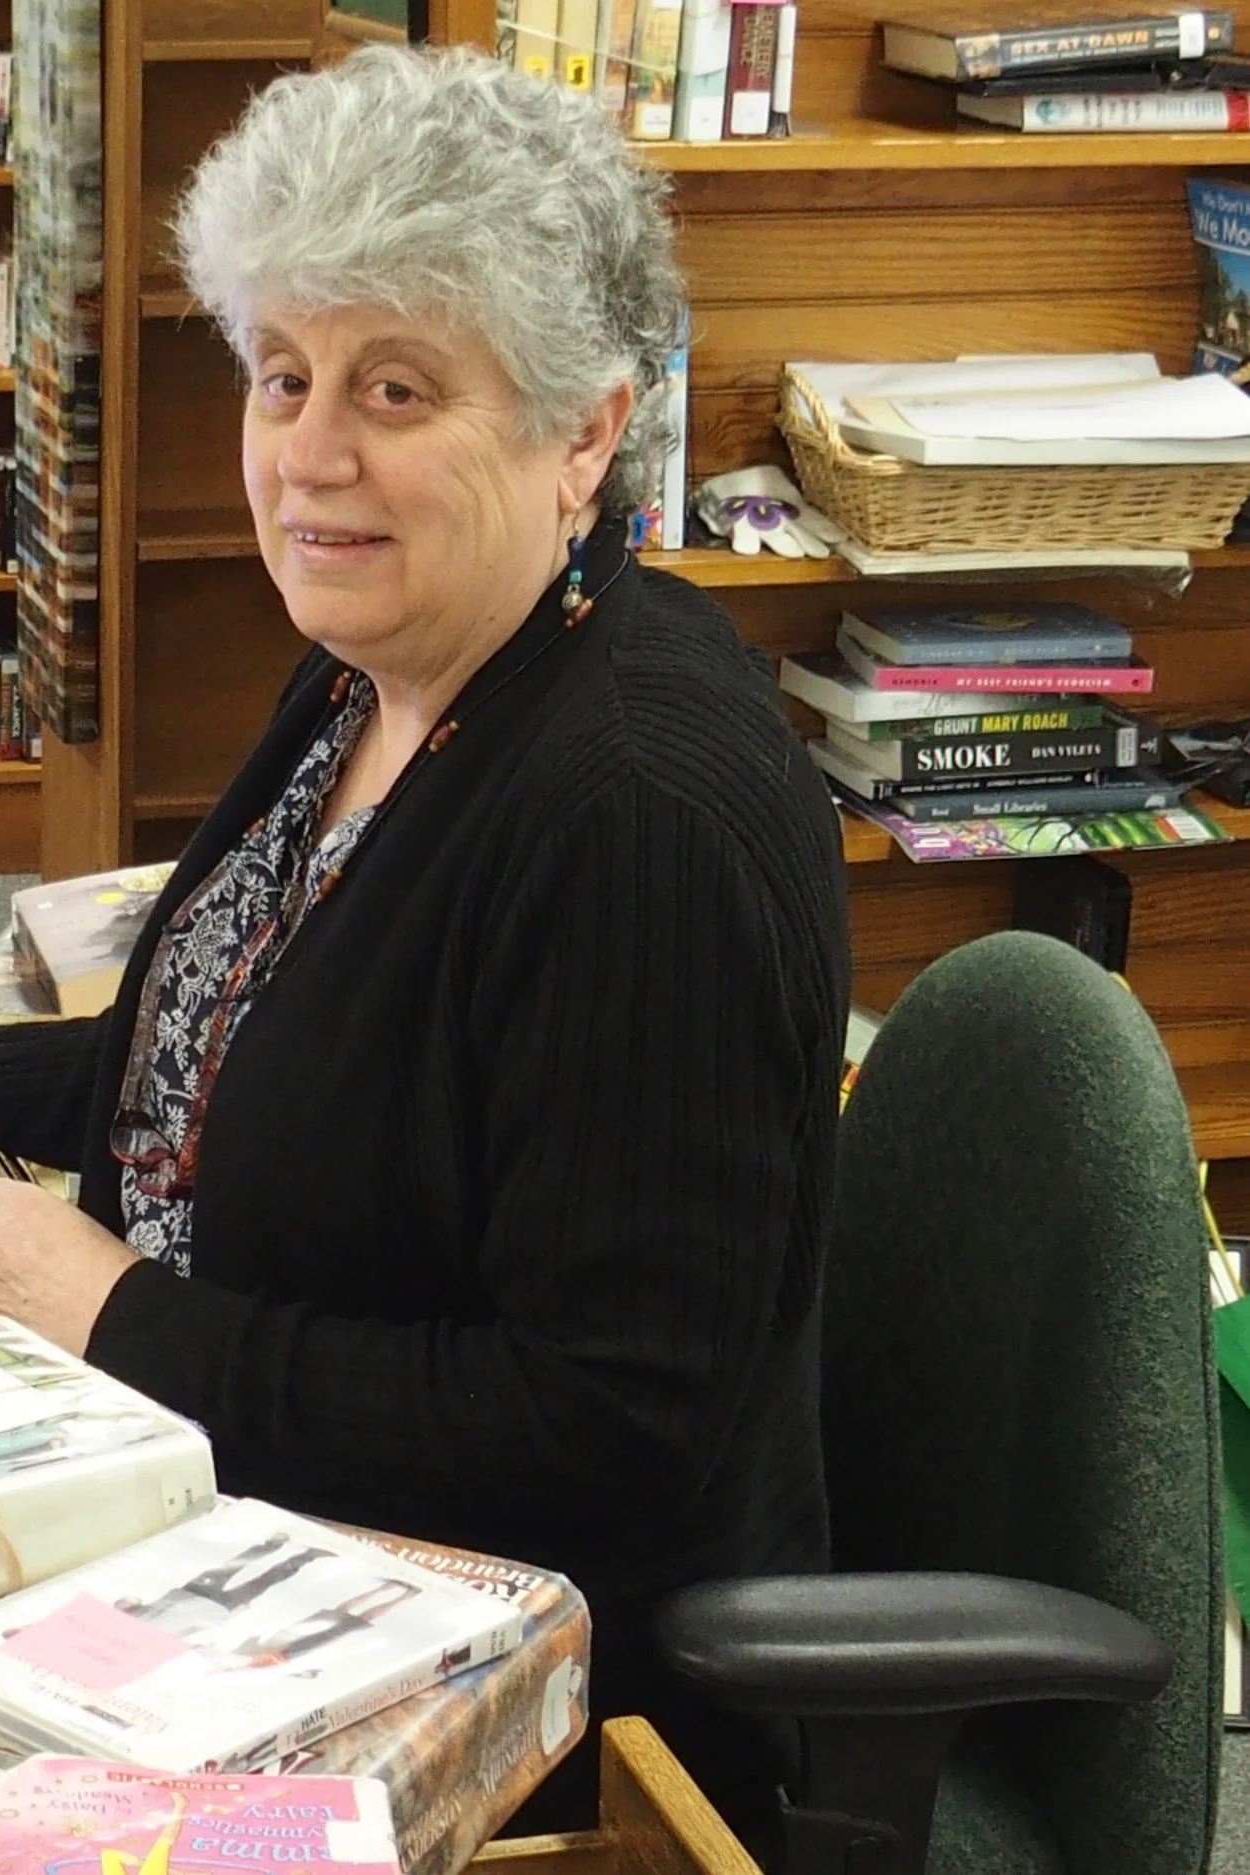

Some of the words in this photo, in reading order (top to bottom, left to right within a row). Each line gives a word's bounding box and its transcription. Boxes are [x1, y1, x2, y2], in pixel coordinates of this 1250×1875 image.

[1010, 39, 1050, 55] SEX
[1056, 36, 1081, 51] AT
[1088, 30, 1149, 48] DAWN
[1195, 210, 1219, 239] We
[933, 716, 979, 736] GRUNT
[981, 713, 1021, 733] MARY
[1022, 712, 1069, 732] ROACH
[916, 743, 1011, 772] SMOKE
[1031, 745, 1056, 758] DAN
[972, 803, 1001, 815] Small
[1002, 800, 1048, 814] Libraries
[396, 1547, 546, 1591] Brandon
[300, 1706, 328, 1730] HATE
[327, 1686, 397, 1729] Valentine's
[399, 1674, 426, 1697] Day
[47, 1797, 108, 1817] Daisy
[242, 1802, 337, 1823] Fairy
[187, 1814, 326, 1841] ymnastics
